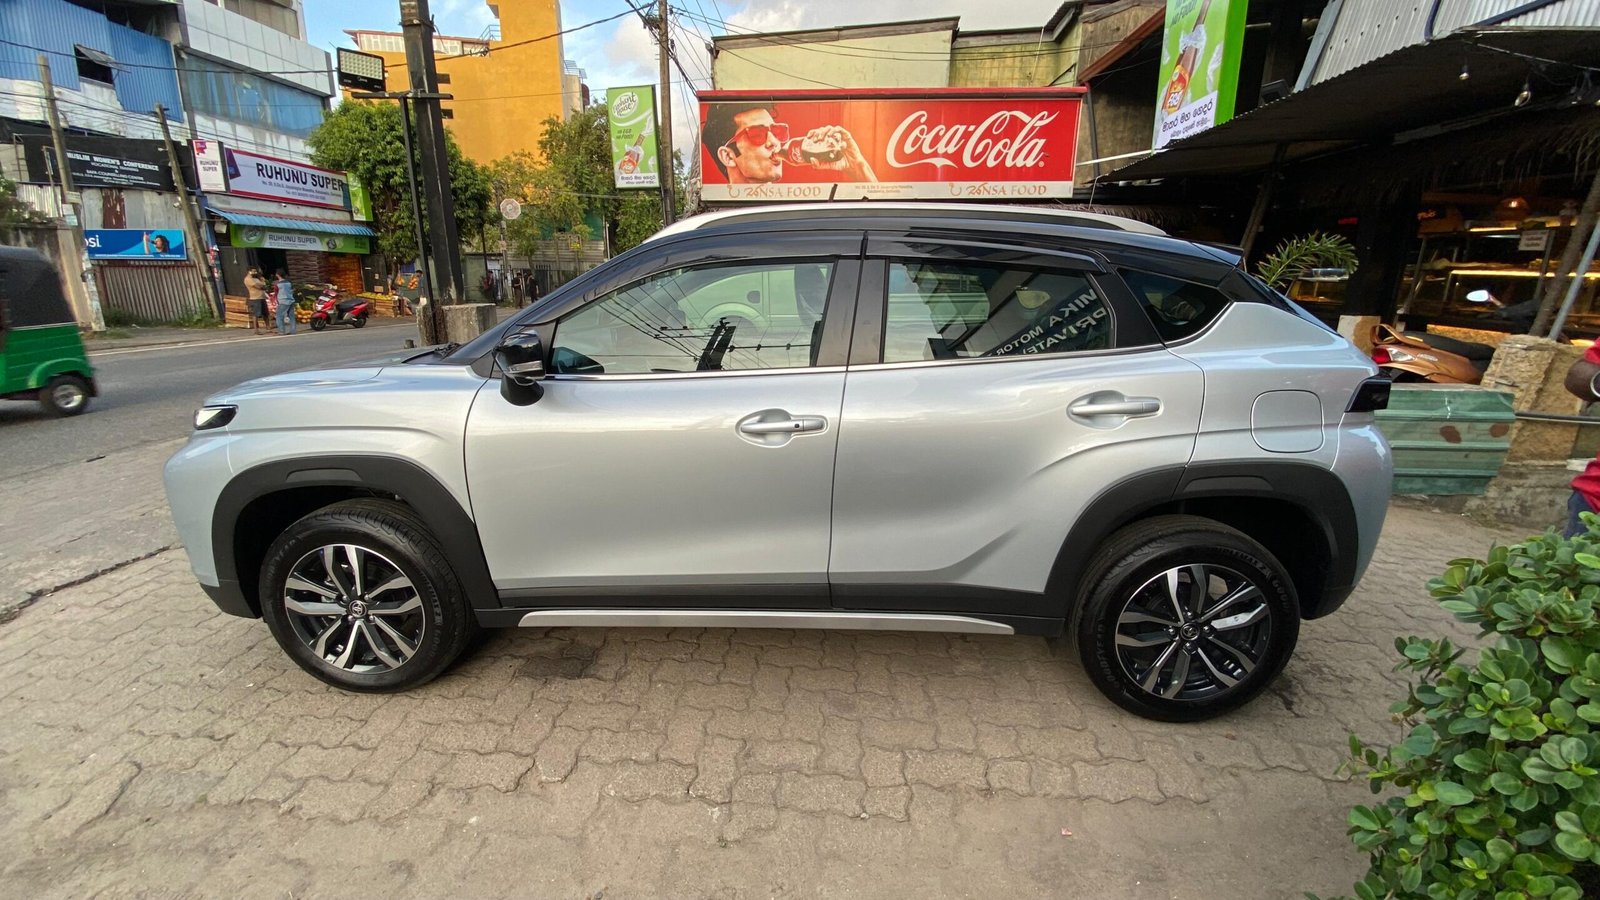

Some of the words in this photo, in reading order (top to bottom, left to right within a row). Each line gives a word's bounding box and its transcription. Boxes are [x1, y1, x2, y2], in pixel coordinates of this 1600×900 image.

[886, 110, 1060, 169] Coca-Cola
[93, 156, 121, 166] WOMEN'S
[123, 160, 159, 171] CONFERENCE
[256, 162, 308, 186] RUHUNU
[310, 173, 344, 192] SUPER
[787, 186, 821, 198] FOOD
[1011, 185, 1047, 196] FOOD
[268, 234, 297, 243] RUHUNU
[297, 236, 317, 244] SUPER
